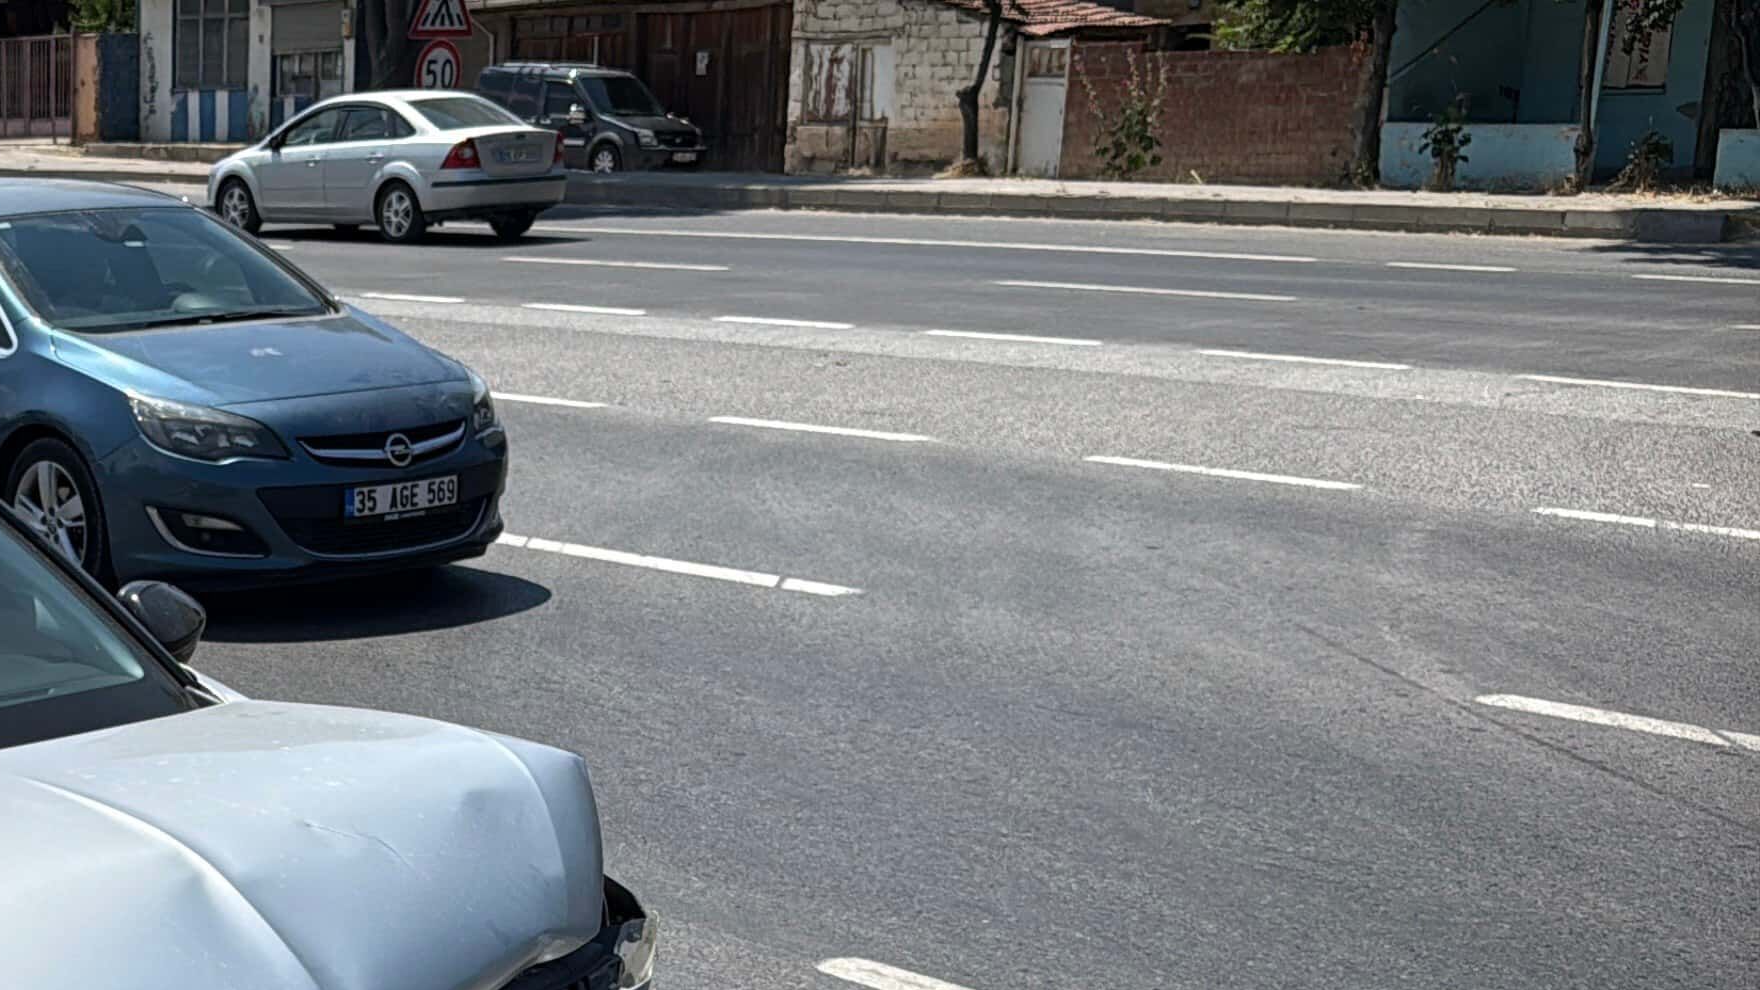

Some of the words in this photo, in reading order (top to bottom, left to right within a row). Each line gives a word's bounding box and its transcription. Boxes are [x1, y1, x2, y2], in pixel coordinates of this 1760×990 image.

[425, 59, 454, 88] 50
[356, 489, 377, 513] 35
[390, 483, 419, 510] AGE
[427, 478, 455, 505] 569
